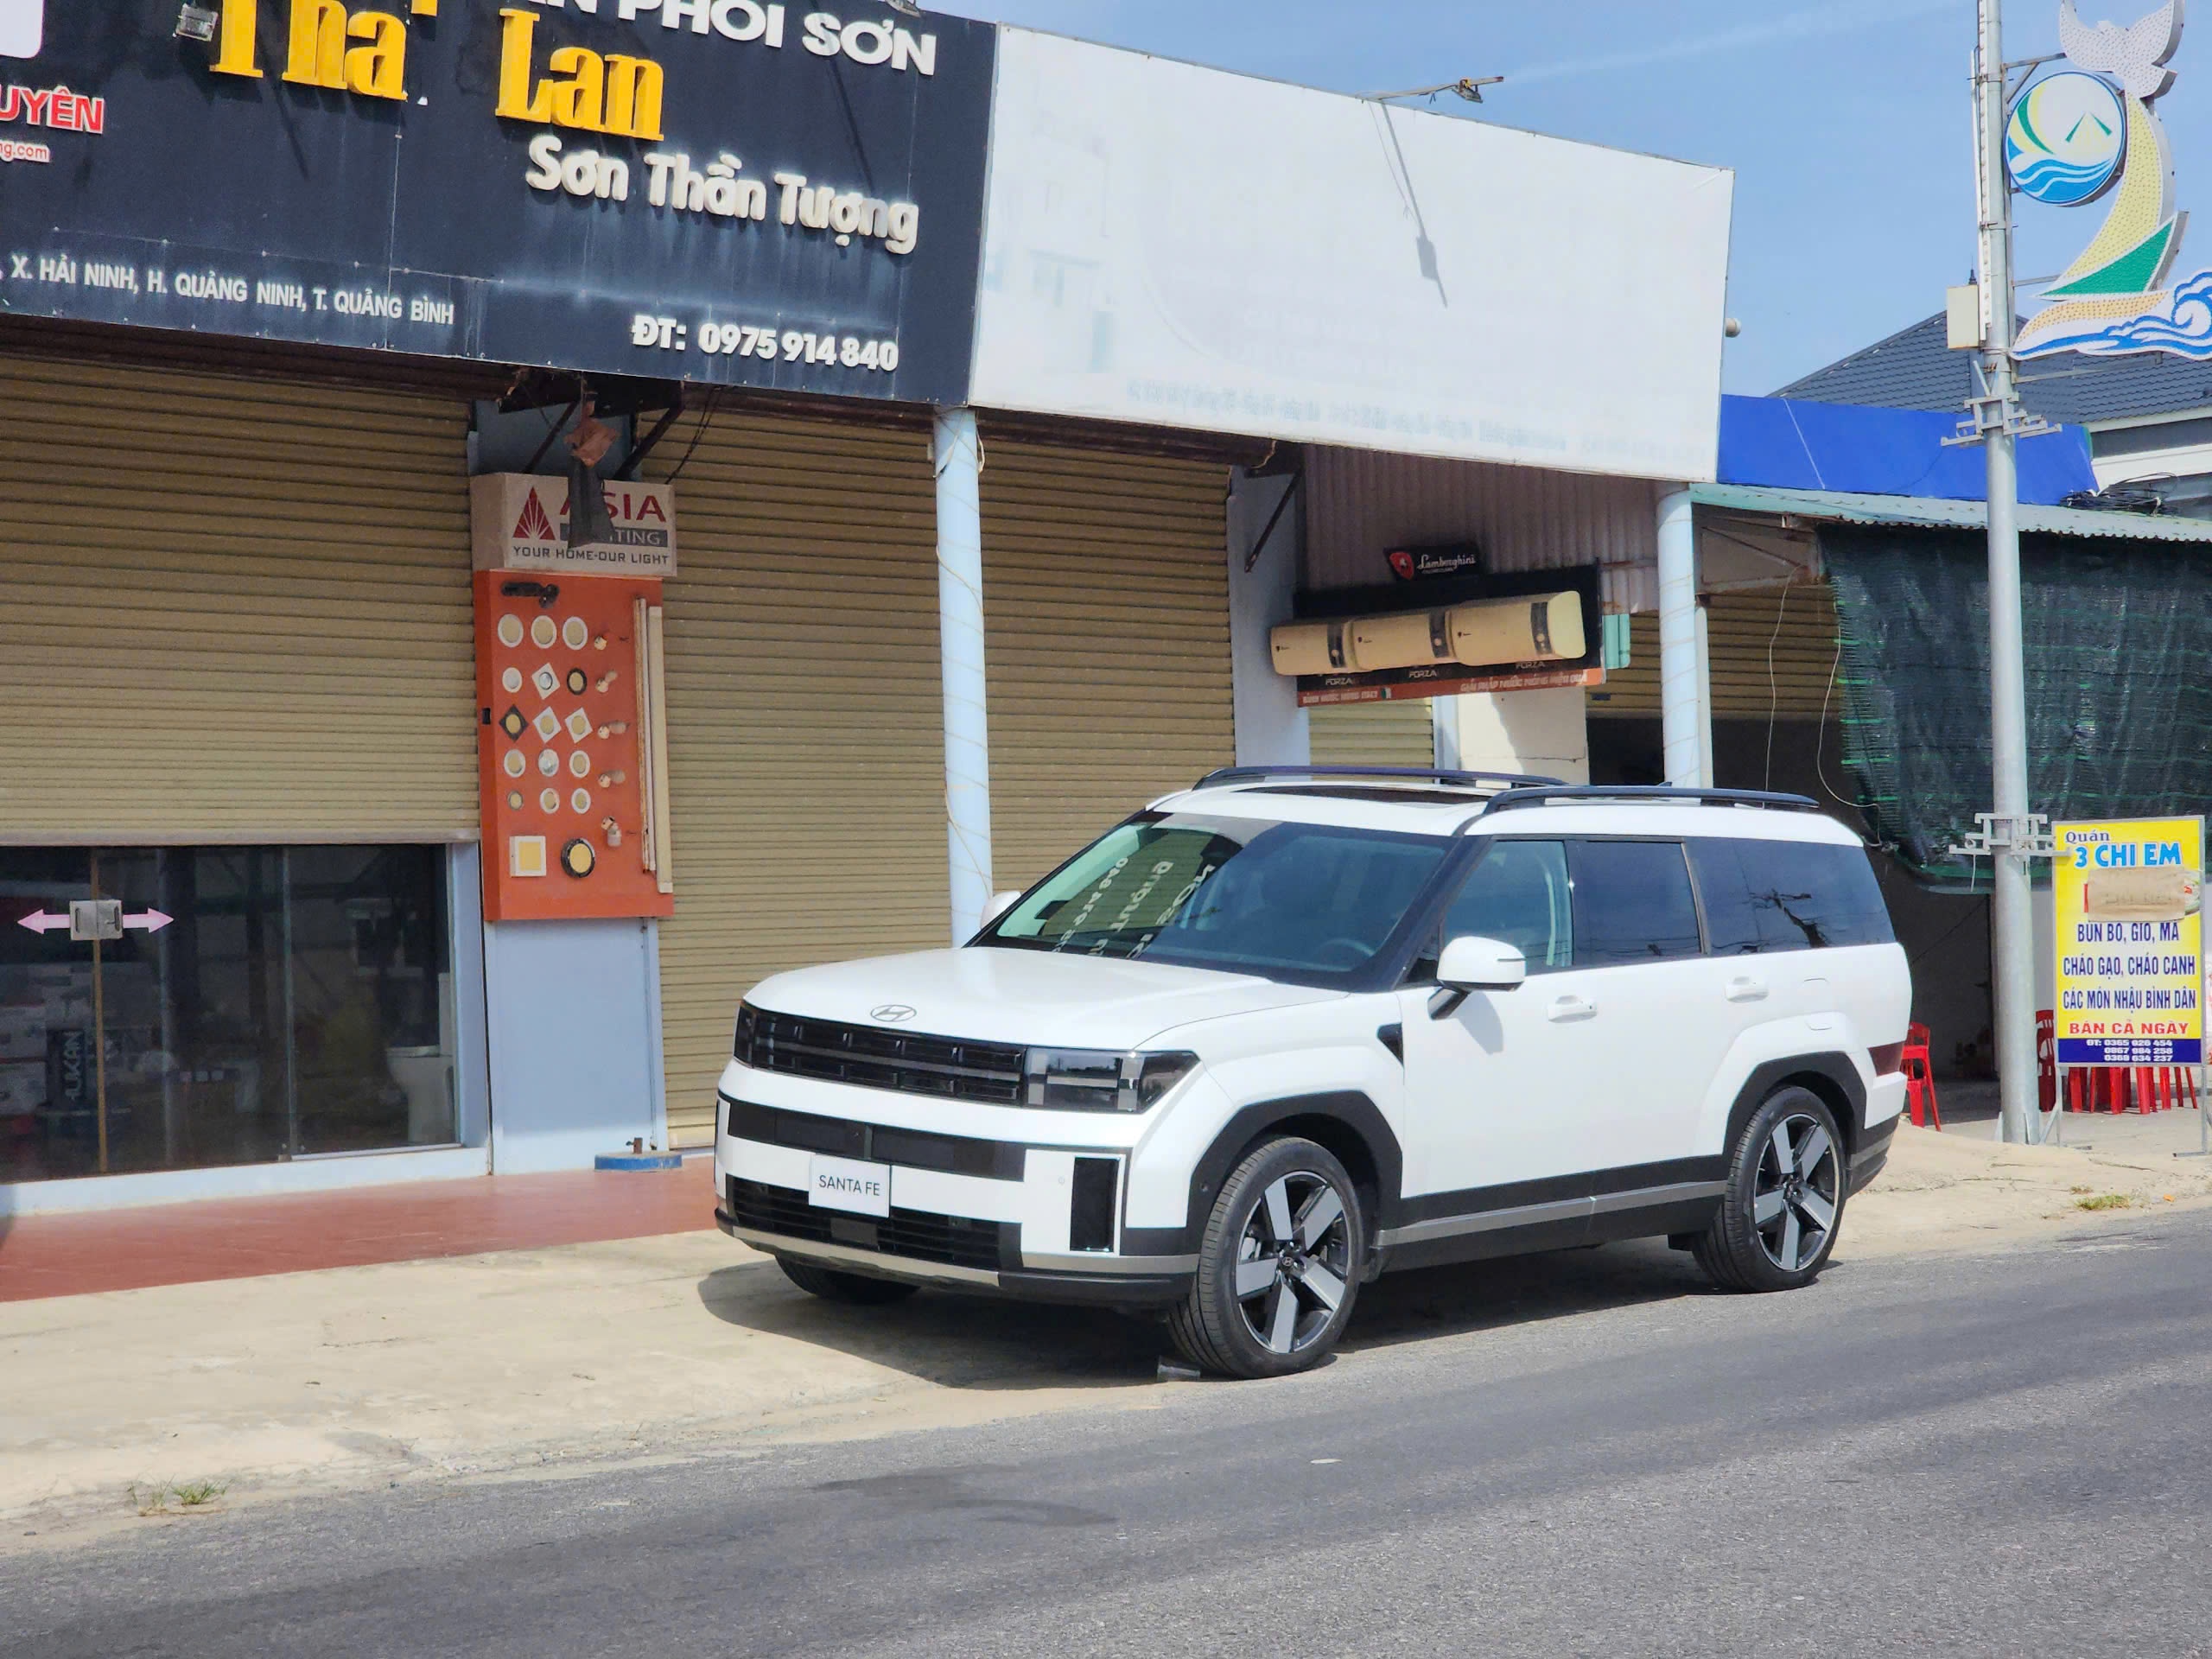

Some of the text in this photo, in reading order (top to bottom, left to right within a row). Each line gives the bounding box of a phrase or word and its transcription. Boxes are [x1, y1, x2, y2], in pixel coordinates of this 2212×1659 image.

[802, 12, 938, 76] SƠN
[495, 8, 664, 142] Lan
[0, 142, 49, 162] g.com
[525, 135, 918, 255] Sơn Thần Tượng
[11, 254, 454, 325] X. HẢI NINH, H. QUẢNG NINH, T. QUẢNG BÌNH
[631, 314, 687, 351] ĐT:
[513, 545, 550, 558] YOUR
[631, 553, 670, 566] LIGHT
[1417, 554, 1476, 570] Lamborghini
[2066, 830, 2110, 843] Quán
[2075, 846, 2088, 868] 3
[2144, 842, 2182, 865] EM
[2063, 952, 2195, 980] CHÁO GẠO, CHÁO CANH
[2063, 986, 2196, 1014] CÁC MÓN NHẬU BÌNH DÂN
[2069, 1020, 2105, 1034] BÁN
[2141, 1020, 2189, 1034] NGÀY
[818, 1174, 880, 1197] SANTA FE
